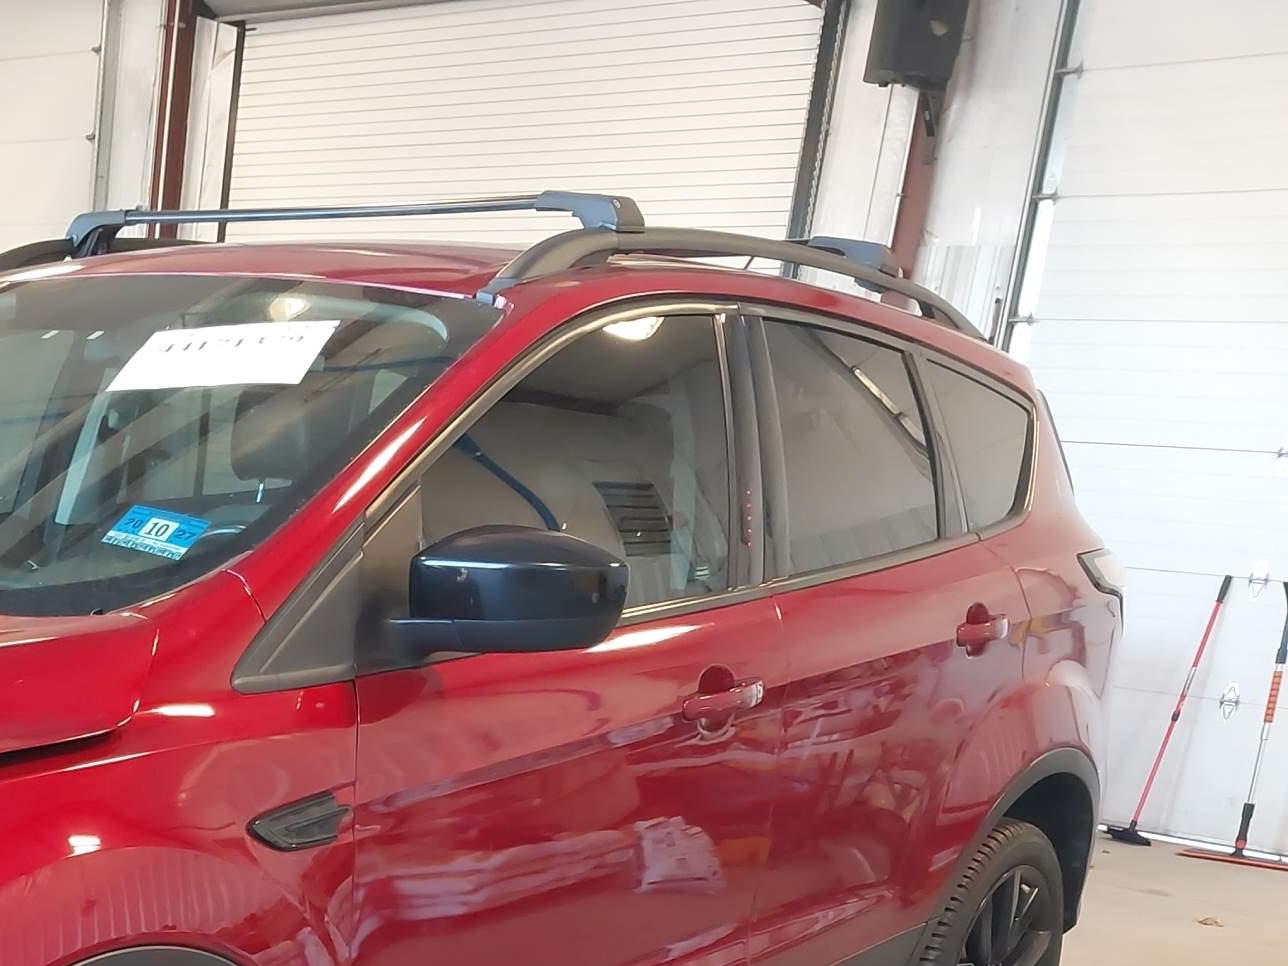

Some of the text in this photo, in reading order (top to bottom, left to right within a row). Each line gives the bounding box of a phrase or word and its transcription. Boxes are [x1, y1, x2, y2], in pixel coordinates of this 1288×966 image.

[123, 518, 197, 541] 20 10 27
